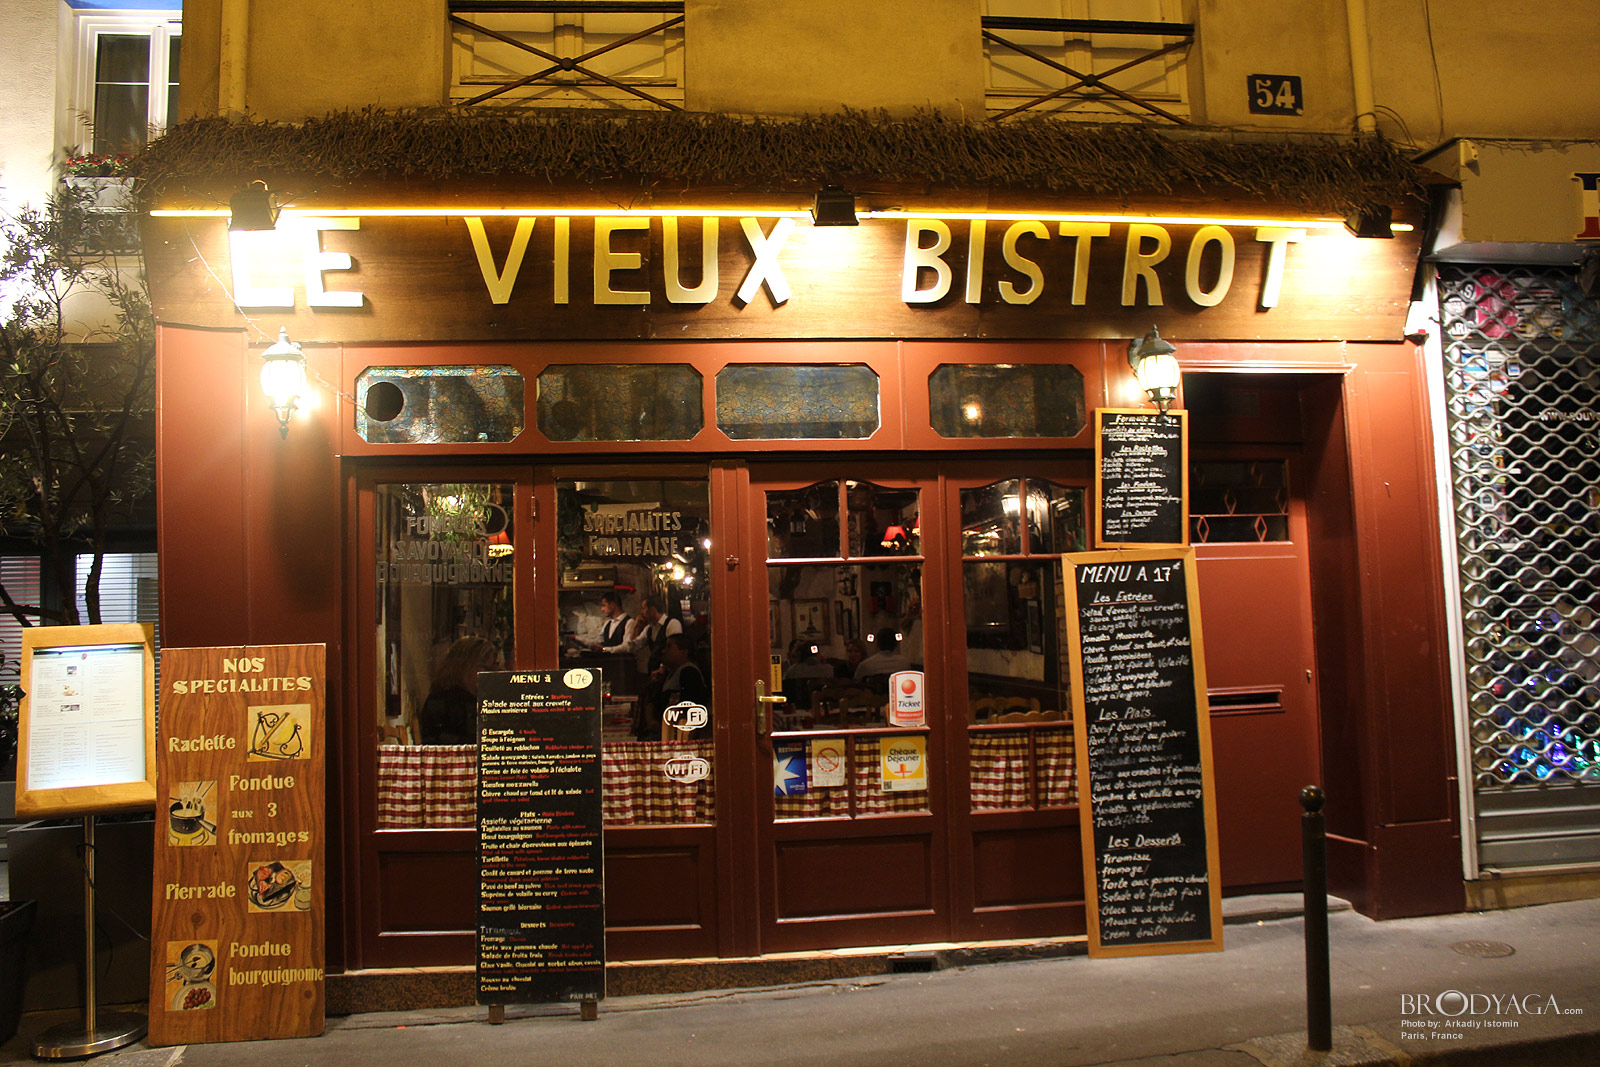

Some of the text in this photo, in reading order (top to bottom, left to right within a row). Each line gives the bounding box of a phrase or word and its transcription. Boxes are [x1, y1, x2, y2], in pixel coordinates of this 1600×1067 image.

[1256, 80, 1295, 109] 54
[229, 216, 1306, 308] LE VIEUX BISTROT
[1081, 564, 1132, 583] MENU
[1136, 566, 1148, 581] A
[1093, 591, 1111, 603] Les
[223, 657, 266, 673] NOS
[173, 676, 313, 694] SPECIALITES
[510, 675, 541, 683] MENU
[1099, 706, 1151, 720] Les Plats
[169, 734, 236, 753] Raclette
[230, 774, 295, 791] Fondue
[232, 802, 277, 819] aux 3
[228, 829, 309, 847] fromages
[1108, 833, 1182, 849] Les Desserts
[166, 881, 236, 900] Pierrade
[230, 941, 291, 958] Fondue
